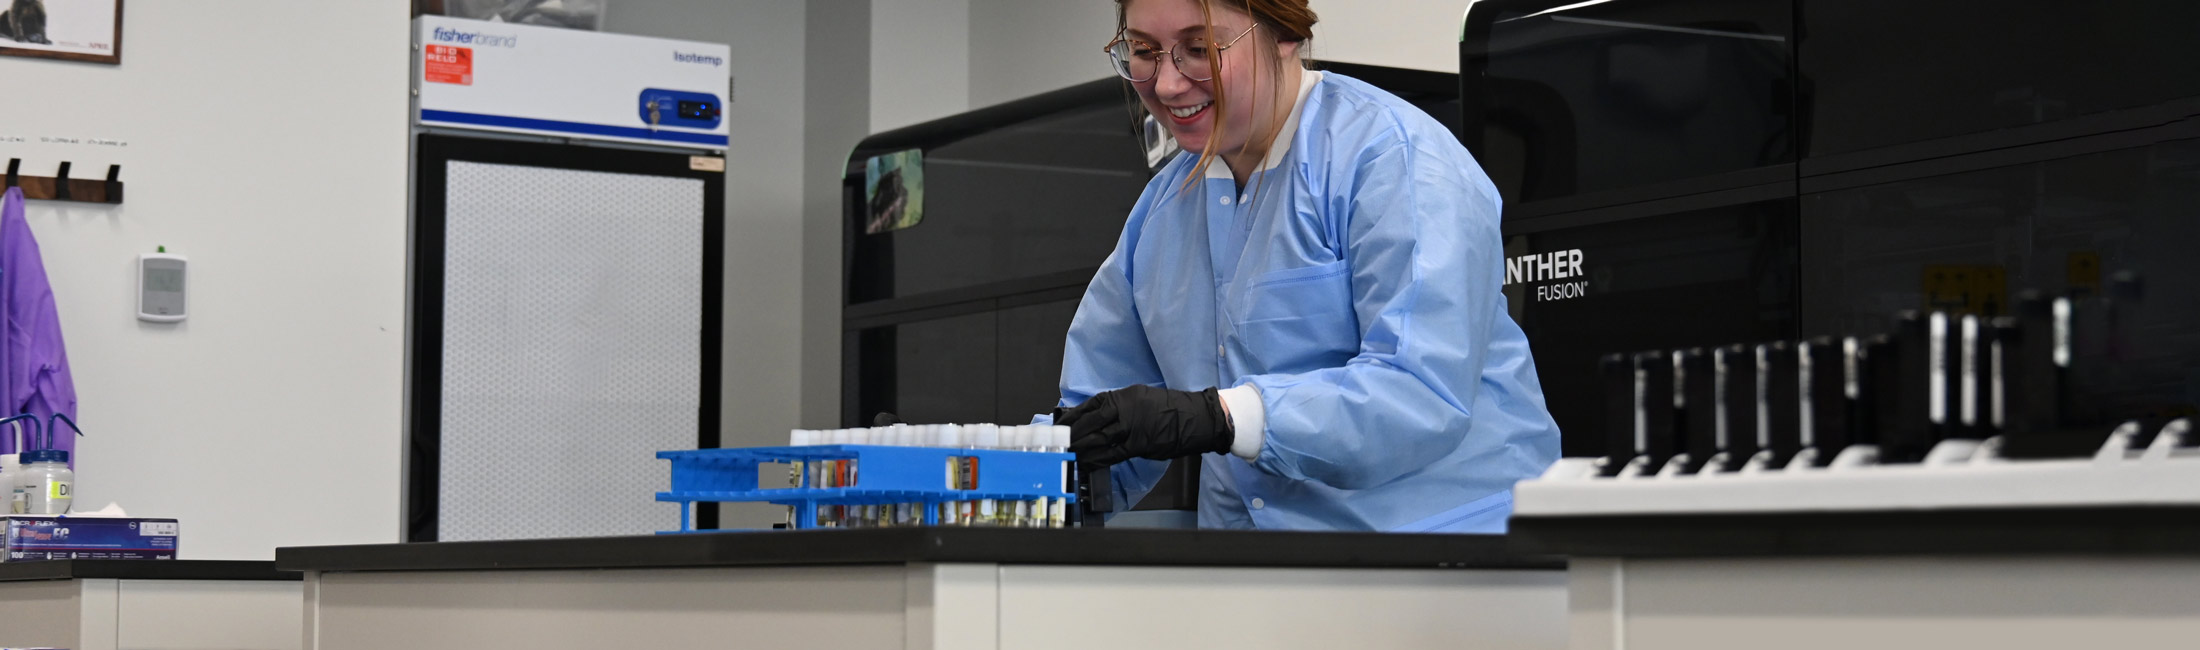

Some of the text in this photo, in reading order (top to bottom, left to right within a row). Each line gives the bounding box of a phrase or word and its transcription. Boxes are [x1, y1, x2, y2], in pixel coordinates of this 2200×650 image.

[433, 26, 517, 48] fisherbrand
[674, 51, 722, 67] Isotemp
[1503, 248, 1584, 286] NTHER
[1537, 281, 1585, 302] FUSION
